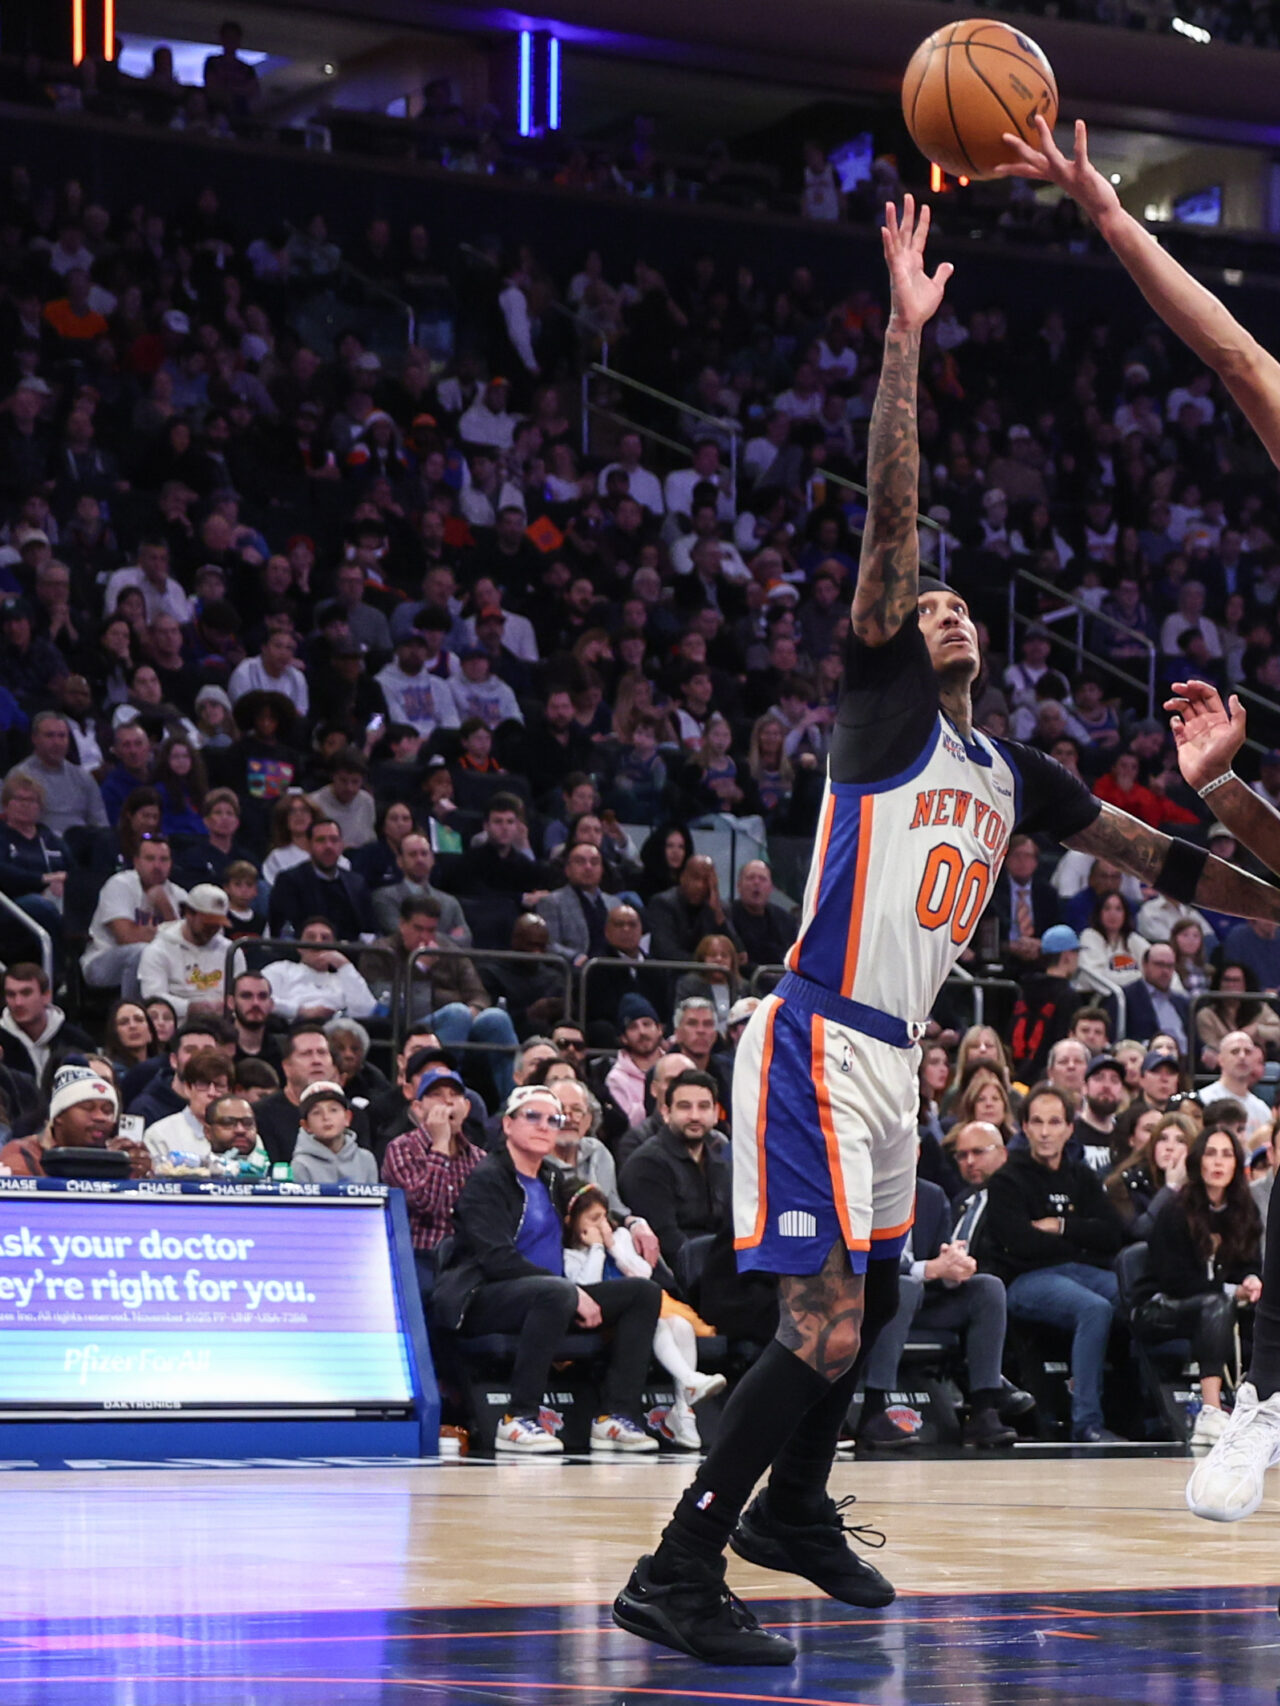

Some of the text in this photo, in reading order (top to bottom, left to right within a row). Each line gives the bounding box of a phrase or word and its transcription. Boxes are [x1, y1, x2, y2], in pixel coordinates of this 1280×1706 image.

[909, 788, 972, 829] NEW
[915, 841, 990, 946] 00
[0, 1179, 37, 1190] HASE
[66, 1180, 110, 1192] CHASE
[138, 1182, 182, 1193] CHASE
[210, 1184, 252, 1195] CHASE
[347, 1185, 388, 1197] CHASE
[0, 1226, 255, 1266] sk your doctor
[91, 1269, 180, 1309] right
[183, 1268, 238, 1301] for
[243, 1280, 317, 1310] you.
[63, 1344, 212, 1385] PfizerForAll
[103, 1400, 183, 1409] DAKTRONICS
